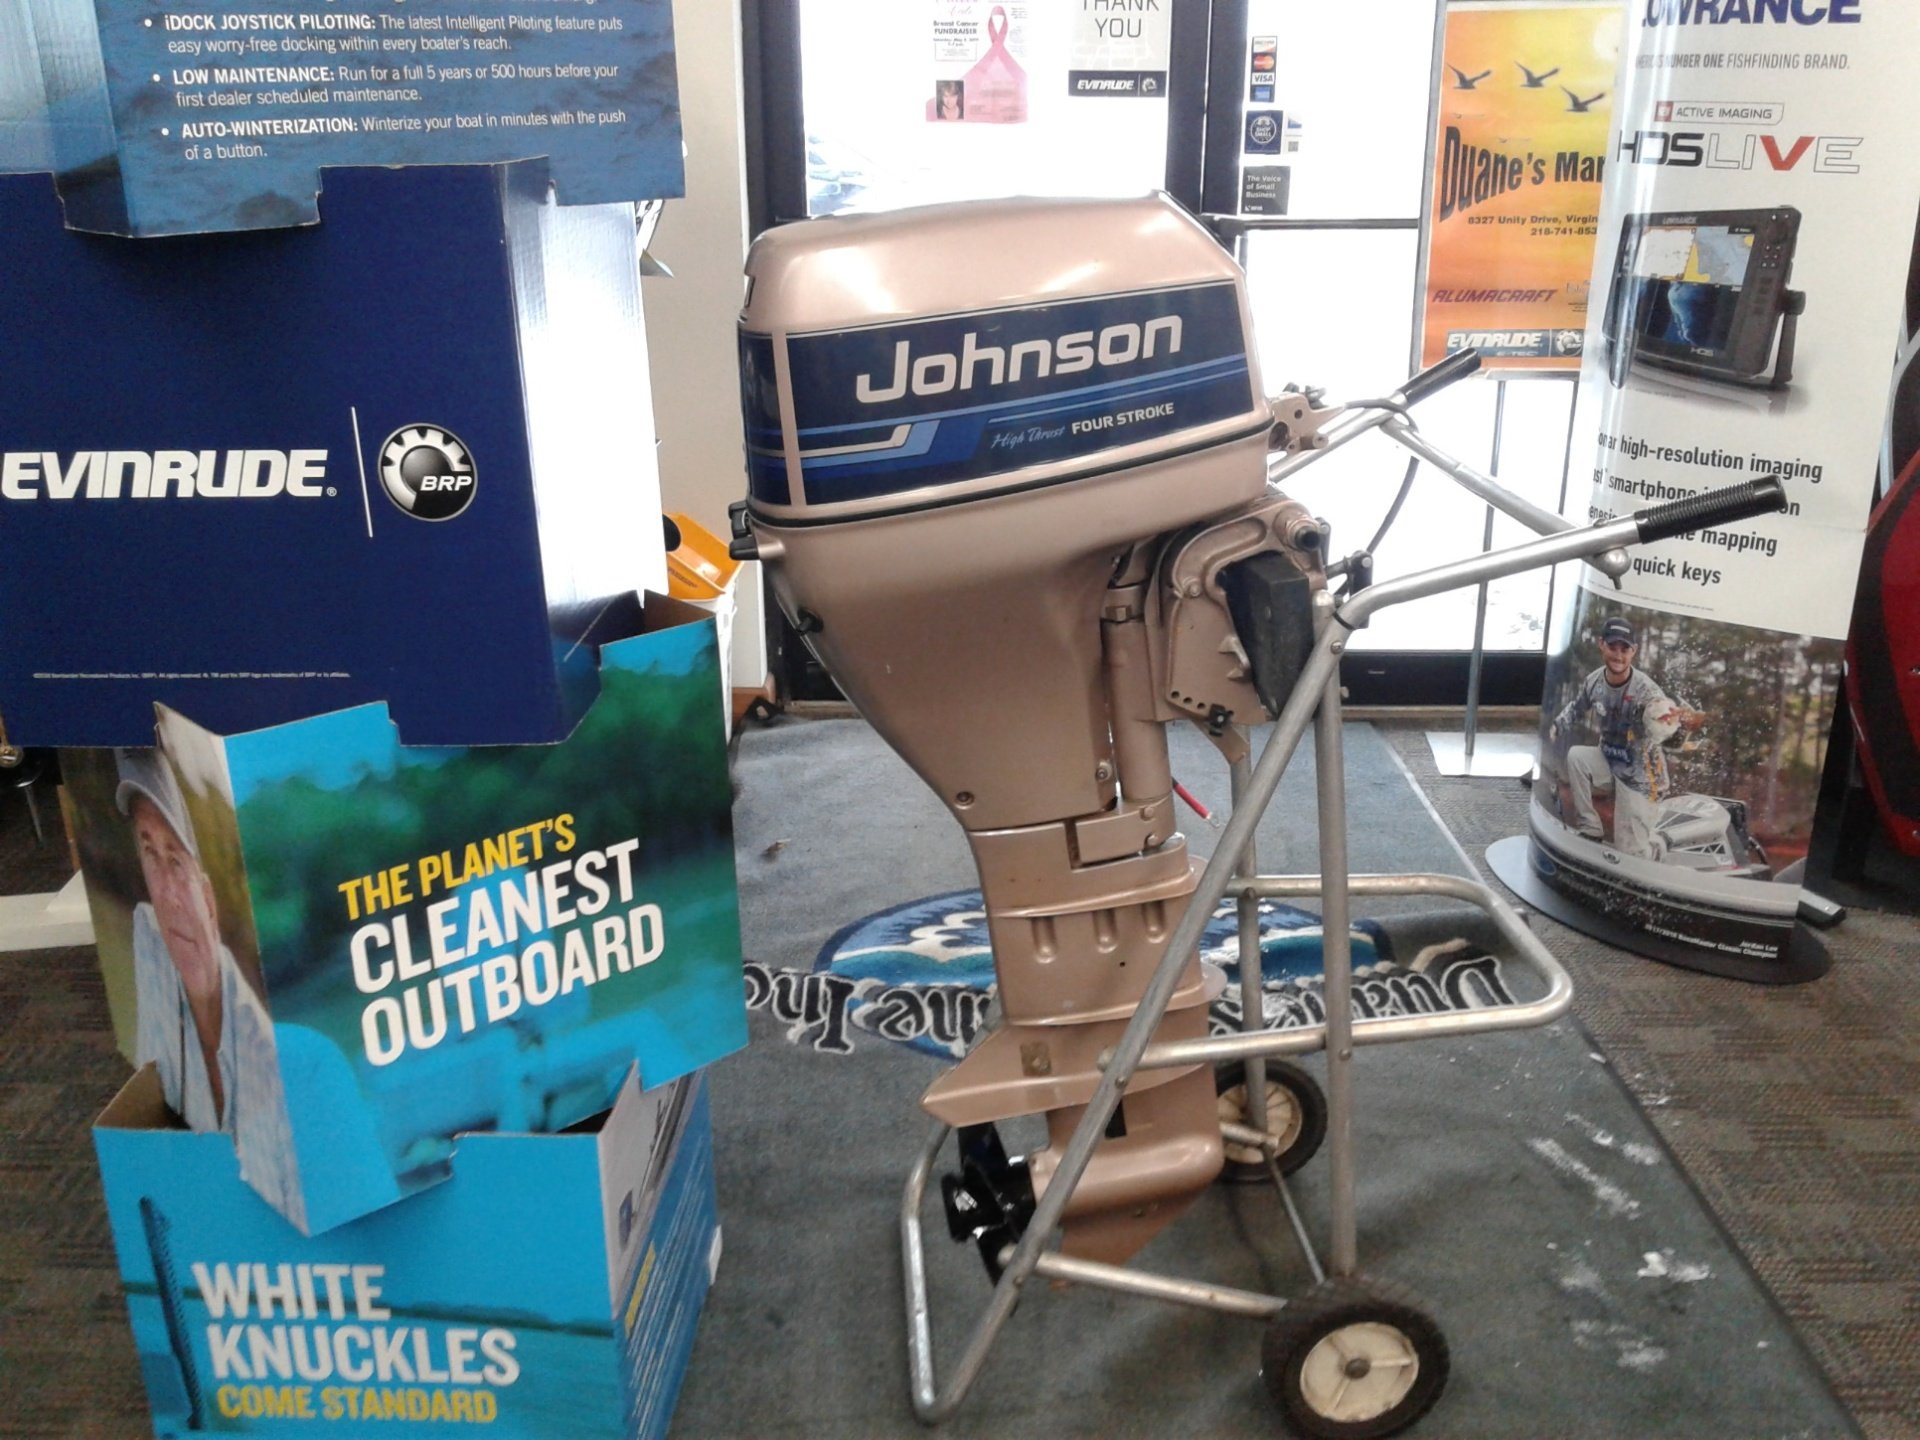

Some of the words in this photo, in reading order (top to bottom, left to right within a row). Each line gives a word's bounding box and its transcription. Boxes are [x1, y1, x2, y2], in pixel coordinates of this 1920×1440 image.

[165, 15, 216, 31] iDOCK
[221, 14, 296, 30] JOYSTICK
[300, 14, 376, 30] PILOTING:
[379, 15, 405, 29] The
[409, 15, 442, 30] latest
[446, 15, 505, 32] Intelligent
[509, 16, 552, 33] Piloting
[555, 16, 595, 30] feature
[598, 17, 623, 32] puts
[1641, 0, 1862, 27] OWRANCE
[1095, 18, 1142, 38] YOU
[168, 38, 201, 56] easy
[205, 38, 277, 55] worry-free
[281, 37, 337, 54] docking
[340, 36, 379, 51] within
[383, 39, 417, 53] every
[421, 36, 470, 50] boater's
[473, 36, 511, 50] reach.
[173, 69, 208, 85] LOW
[214, 67, 335, 84] MAINTENANCE:
[340, 67, 367, 81] Run
[371, 66, 387, 81] for
[392, 69, 400, 80] a
[403, 65, 423, 80] full
[427, 65, 436, 79] 5
[439, 67, 472, 82] years
[475, 68, 487, 78] or
[491, 64, 515, 79] 500
[519, 64, 552, 78] hours
[555, 63, 591, 78] before
[594, 65, 618, 80] your
[1703, 54, 1723, 68] ONE
[1727, 53, 1799, 69] FISHFINDING
[1804, 54, 1850, 70] BRAND.
[176, 92, 205, 107] first
[208, 91, 252, 106] dealer
[257, 89, 328, 105] scheduled
[333, 87, 423, 102] maintenance.
[1077, 79, 1135, 90] EVINRUDE
[182, 118, 358, 139] AUTO-WINTERIZATION:
[361, 116, 422, 132] Winterize
[424, 117, 452, 133] your
[456, 114, 483, 129] boat
[486, 113, 497, 127] in
[501, 112, 548, 127] minutes
[551, 111, 575, 125] with
[577, 111, 596, 124] the
[598, 109, 626, 125] push
[1676, 107, 1714, 118] ACTIVE
[1718, 107, 1772, 119] IMAGING
[185, 145, 199, 160] of
[203, 149, 212, 160] a
[217, 144, 268, 159] button.
[1440, 126, 1546, 223] Duane's
[1498, 216, 1527, 225] Unity
[1530, 215, 1562, 225] Drive,
[1432, 289, 1558, 303] ALUMACRAFT
[1447, 333, 1542, 347] EVINRUDE
[856, 315, 1183, 402] Johnson
[990, 432, 1025, 449] High
[1028, 426, 1066, 442] Thrust
[1071, 417, 1114, 435] FOUR
[1117, 402, 1175, 426] STROKE
[1620, 434, 1744, 470] high-resolution
[1750, 453, 1823, 484] imaging
[420, 475, 473, 492] BRP
[1701, 529, 1778, 557] mapping
[1633, 556, 1675, 578] quick
[1681, 561, 1721, 586] keys
[338, 863, 414, 922] THE
[418, 813, 577, 898] PLANET'S
[350, 838, 640, 994] CLEANEST
[360, 903, 665, 1067] OUTBOARD
[191, 1262, 391, 1321] WHITE
[207, 1324, 520, 1386] KNUCKLES
[217, 1385, 316, 1419] COME
[321, 1386, 497, 1423] STANDARD
